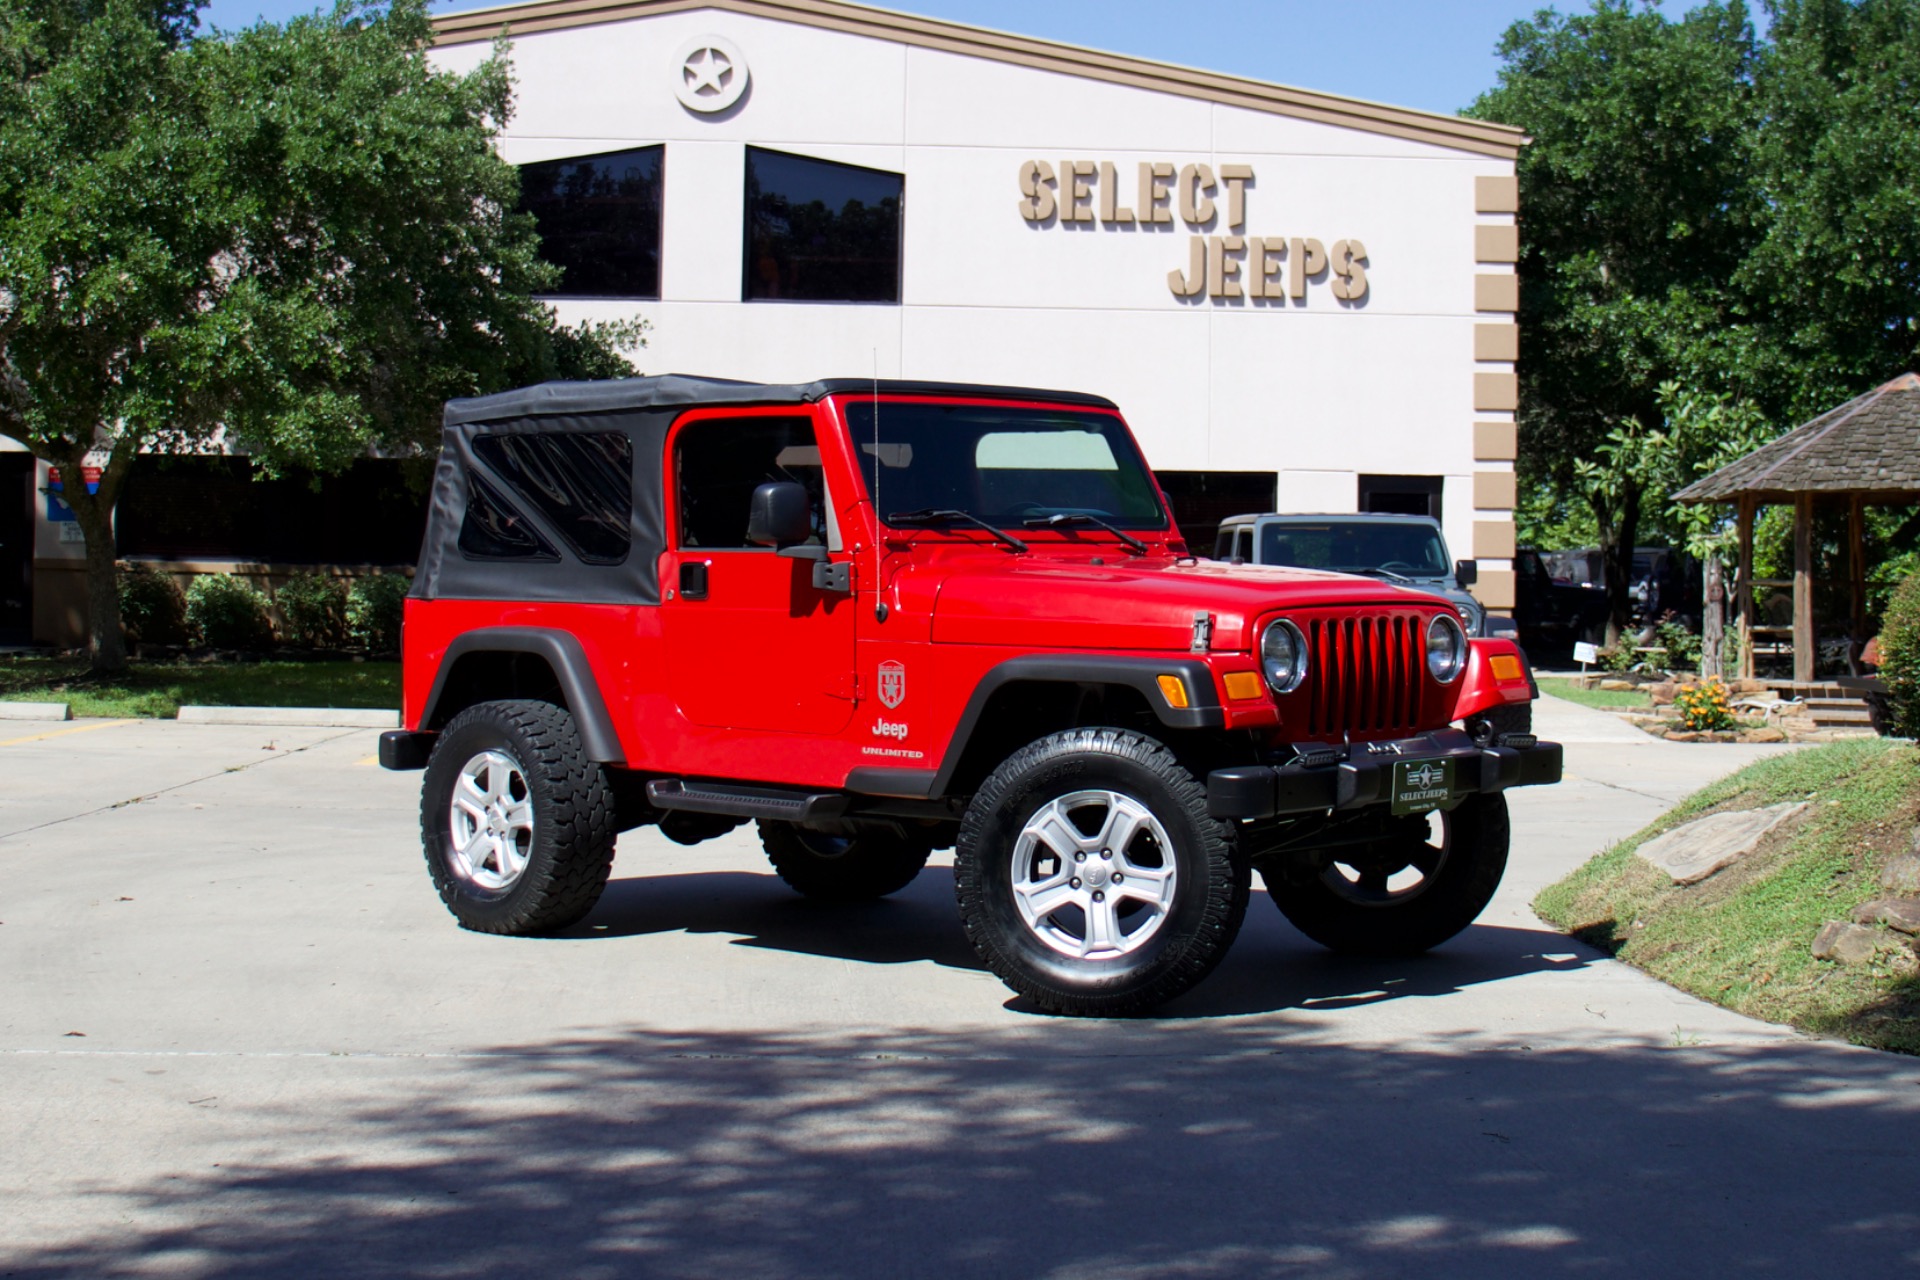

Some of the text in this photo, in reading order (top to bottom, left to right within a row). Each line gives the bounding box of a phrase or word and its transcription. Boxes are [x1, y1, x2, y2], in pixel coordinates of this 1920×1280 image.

[1018, 159, 1255, 229] SELECT
[1167, 236, 1369, 300] JEEPS
[872, 718, 908, 740] Jeep
[862, 746, 924, 758] UNLIMITED
